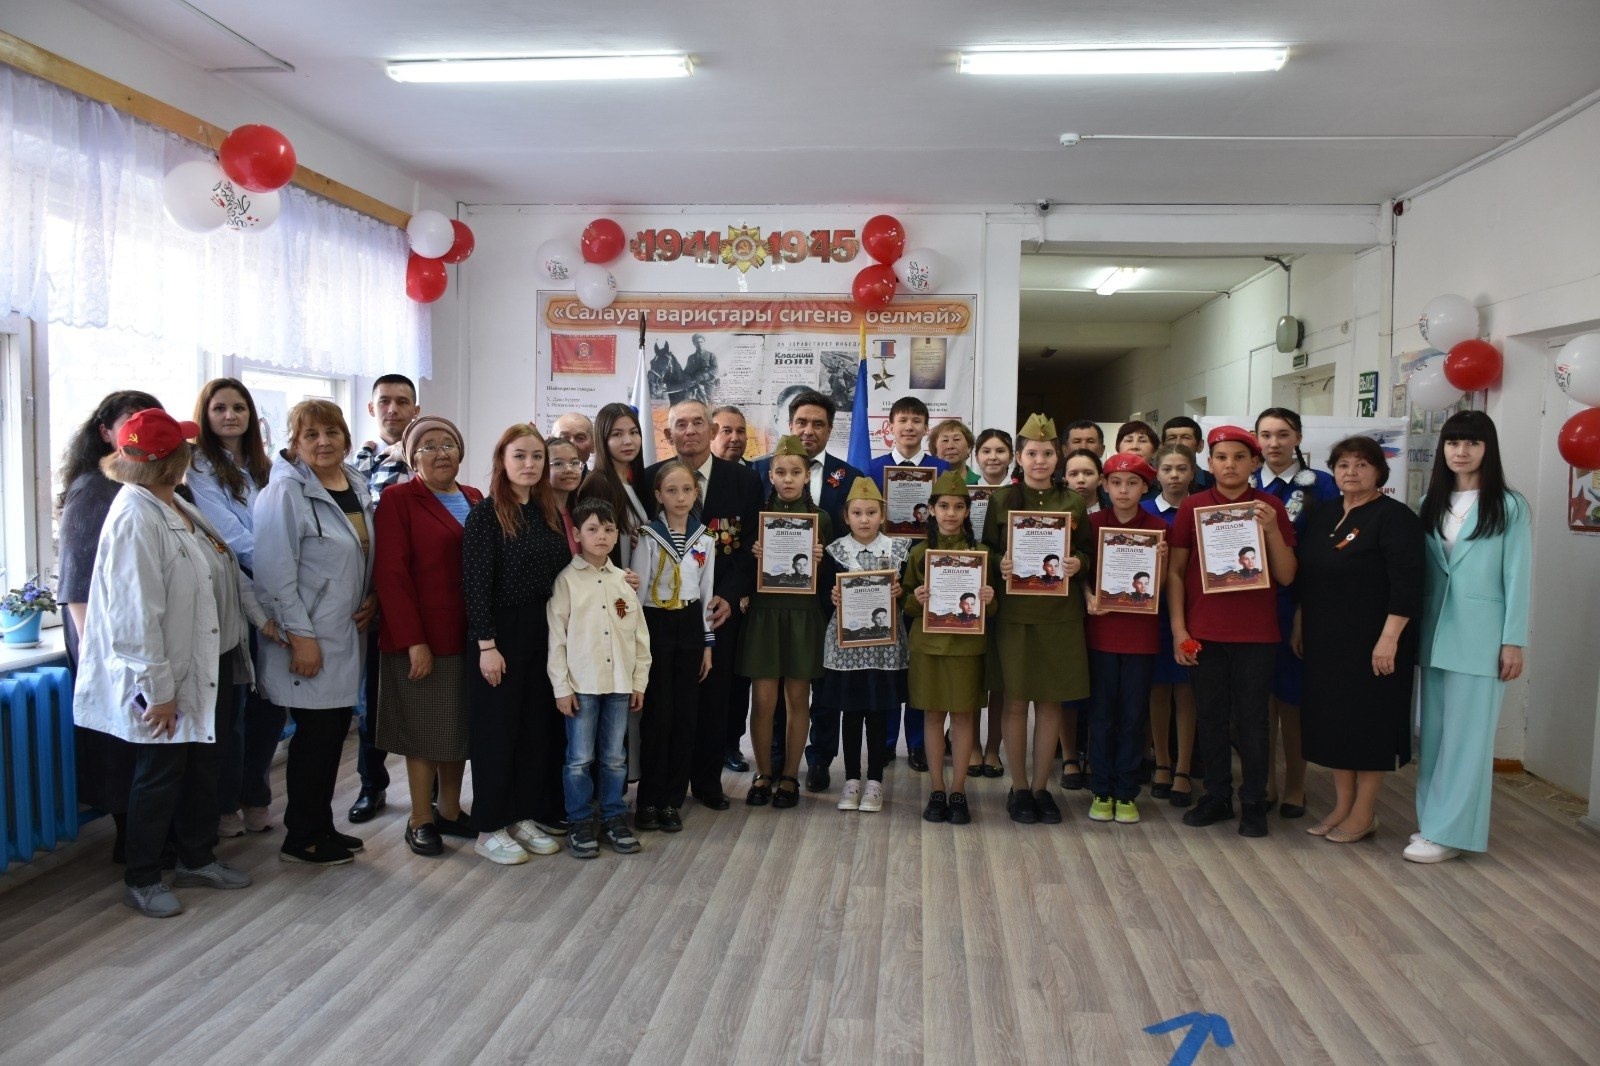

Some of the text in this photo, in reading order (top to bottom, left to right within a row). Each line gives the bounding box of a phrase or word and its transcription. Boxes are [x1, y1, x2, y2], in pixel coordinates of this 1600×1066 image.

[637, 228, 858, 265] 1941 1945
[865, 307, 962, 324] белмәй»
[1215, 523, 1245, 531] ДИПЛОМ
